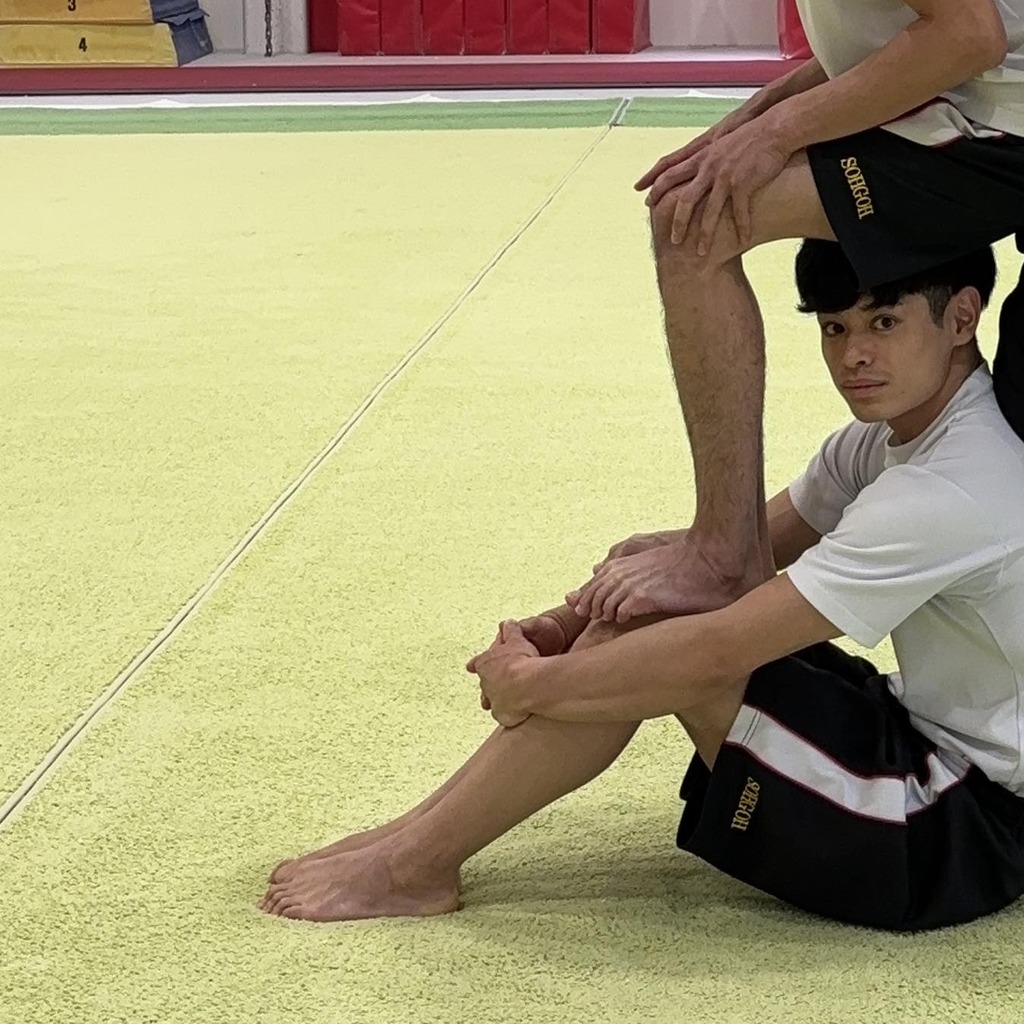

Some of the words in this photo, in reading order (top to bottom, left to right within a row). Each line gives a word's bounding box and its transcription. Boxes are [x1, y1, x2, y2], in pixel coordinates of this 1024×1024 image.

[78, 37, 88, 52] 4
[840, 157, 875, 220] SOHGOH
[731, 776, 760, 831] SOHGOH
